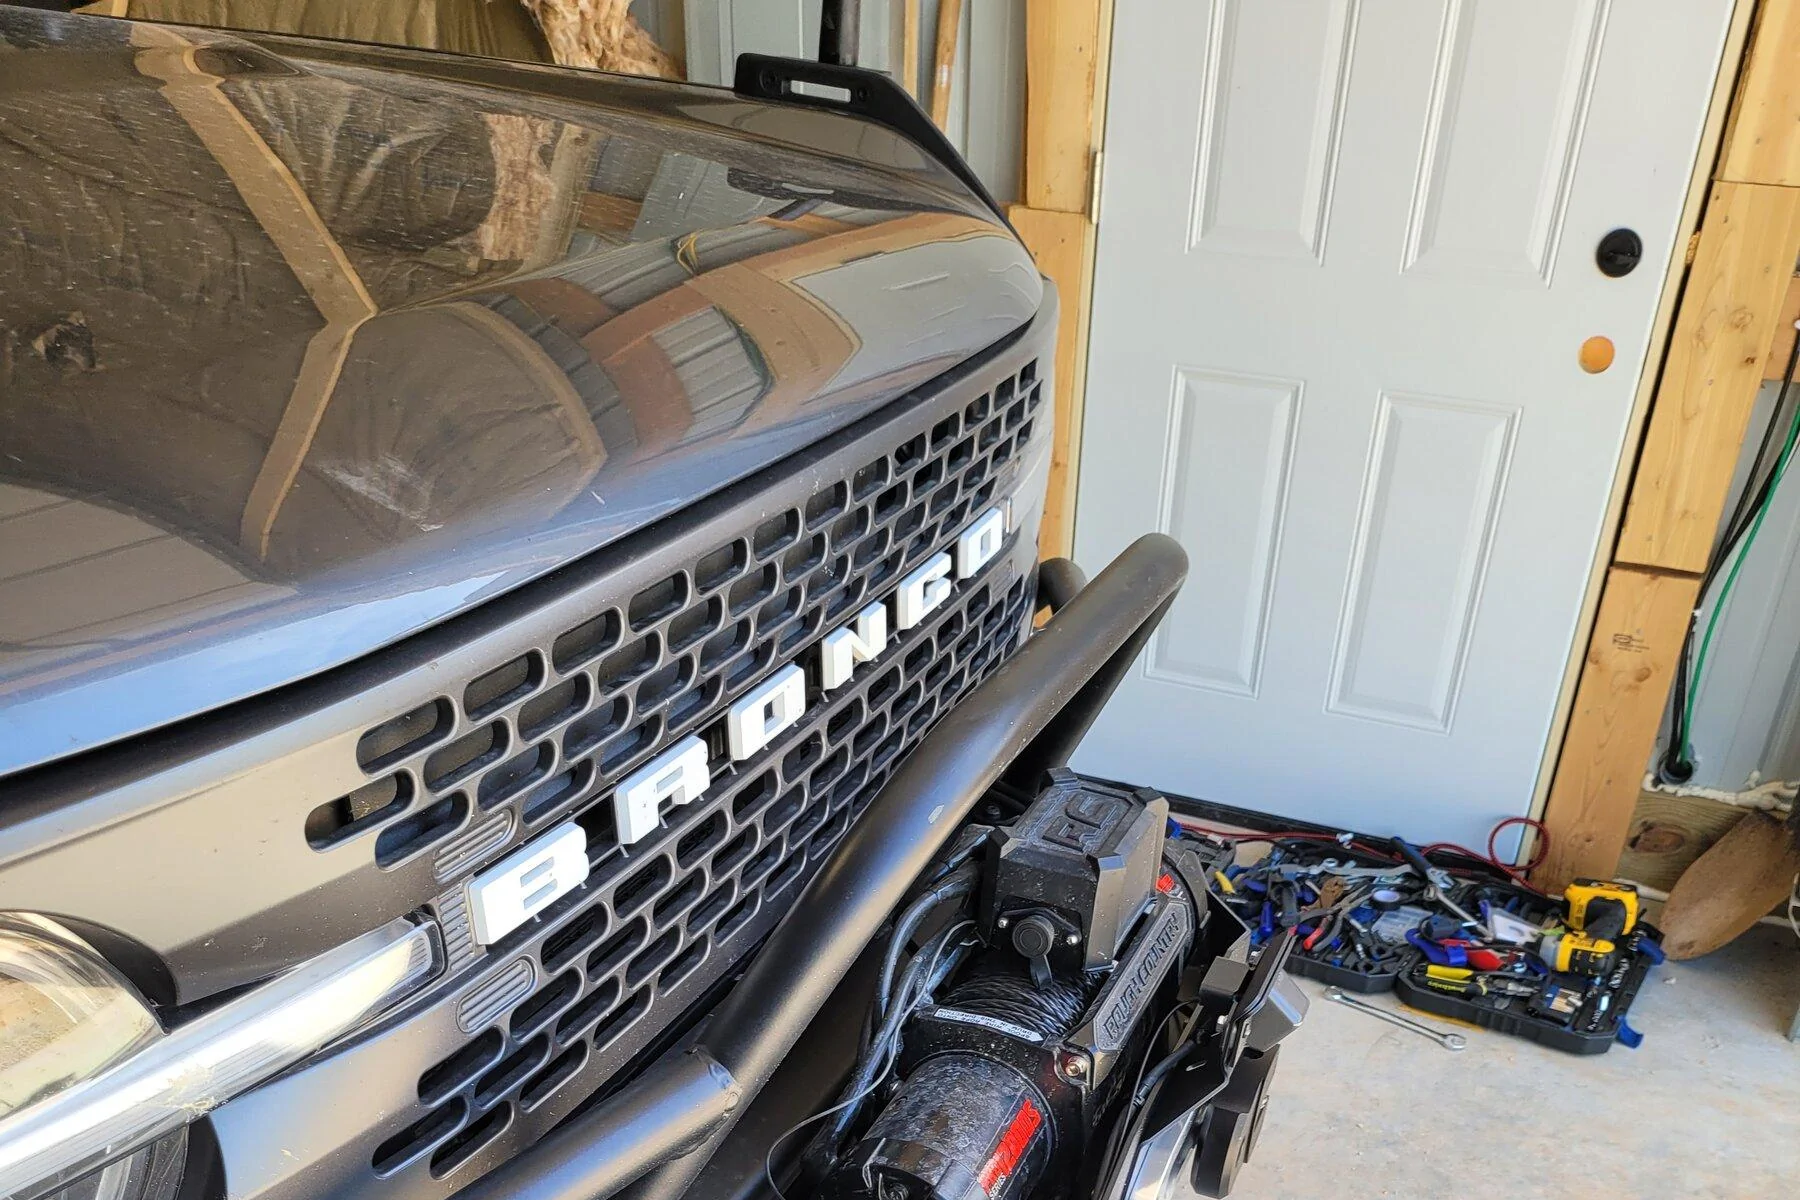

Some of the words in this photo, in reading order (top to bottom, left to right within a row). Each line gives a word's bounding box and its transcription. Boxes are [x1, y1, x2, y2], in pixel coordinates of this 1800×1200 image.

[467, 508, 1003, 946] BRONCO
[1103, 976, 1142, 1039] ROUGH
[1137, 912, 1180, 986] COUNTRY
[988, 1173, 1006, 1200] SERIES
